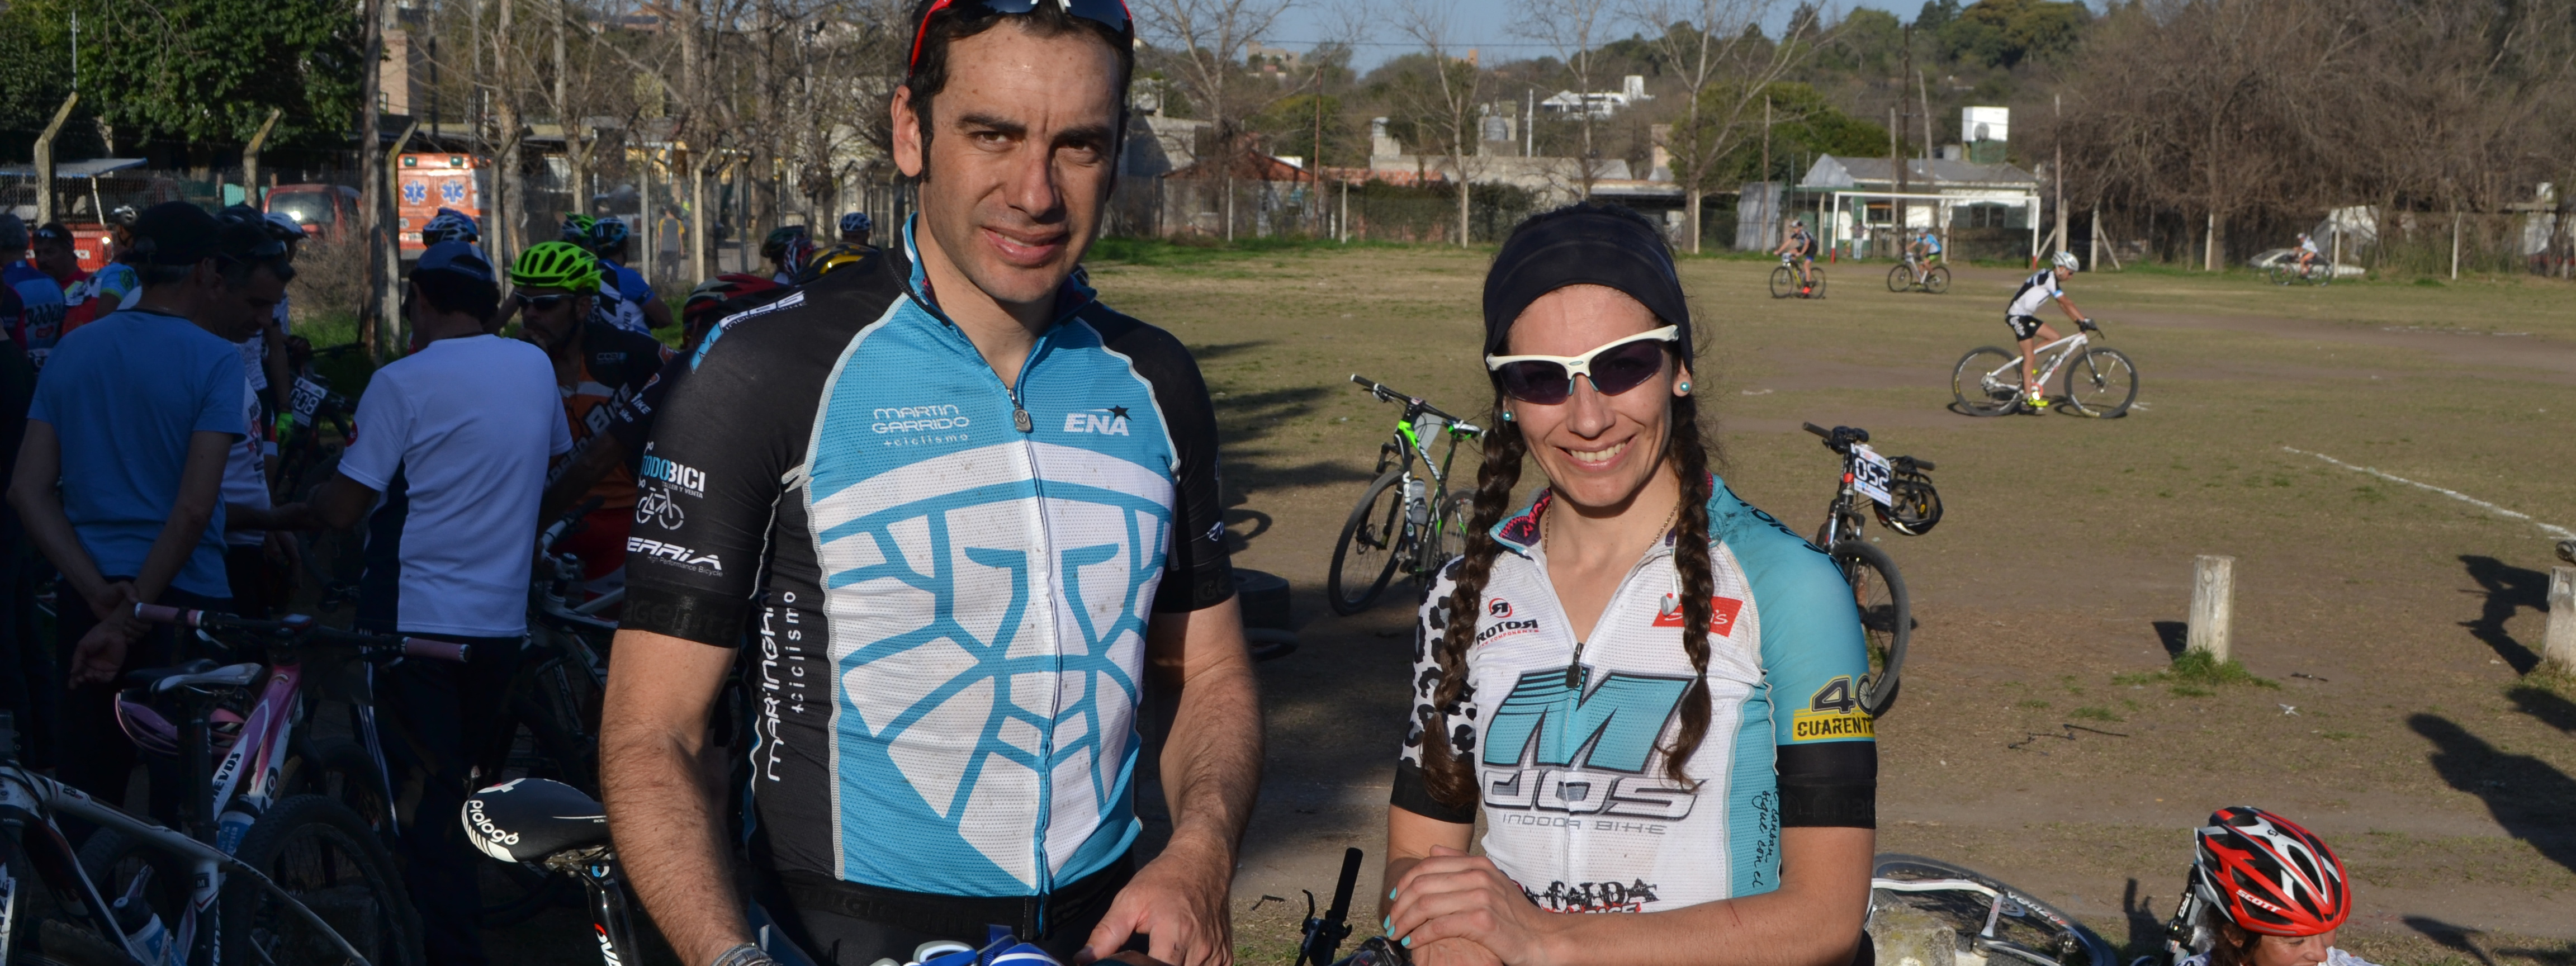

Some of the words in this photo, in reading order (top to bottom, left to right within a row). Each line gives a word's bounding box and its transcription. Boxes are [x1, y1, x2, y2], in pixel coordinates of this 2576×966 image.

[873, 404, 959, 420] MARTIN
[872, 416, 970, 434] GARRIDO
[1063, 413, 1130, 436] ENA
[1855, 457, 1890, 492] 052
[685, 489, 703, 499] VENTA
[627, 536, 722, 571] ERRIA
[660, 557, 697, 571] Performance
[698, 566, 723, 577] Bicycle
[1476, 619, 1538, 645] ROTOR
[1490, 629, 1540, 642] COMPONENTS
[469, 800, 519, 845] prologo
[1751, 790, 1772, 834] sigue
[1754, 840, 1766, 868] con
[1752, 871, 1764, 888] el
[2236, 889, 2282, 913] SCOTT
